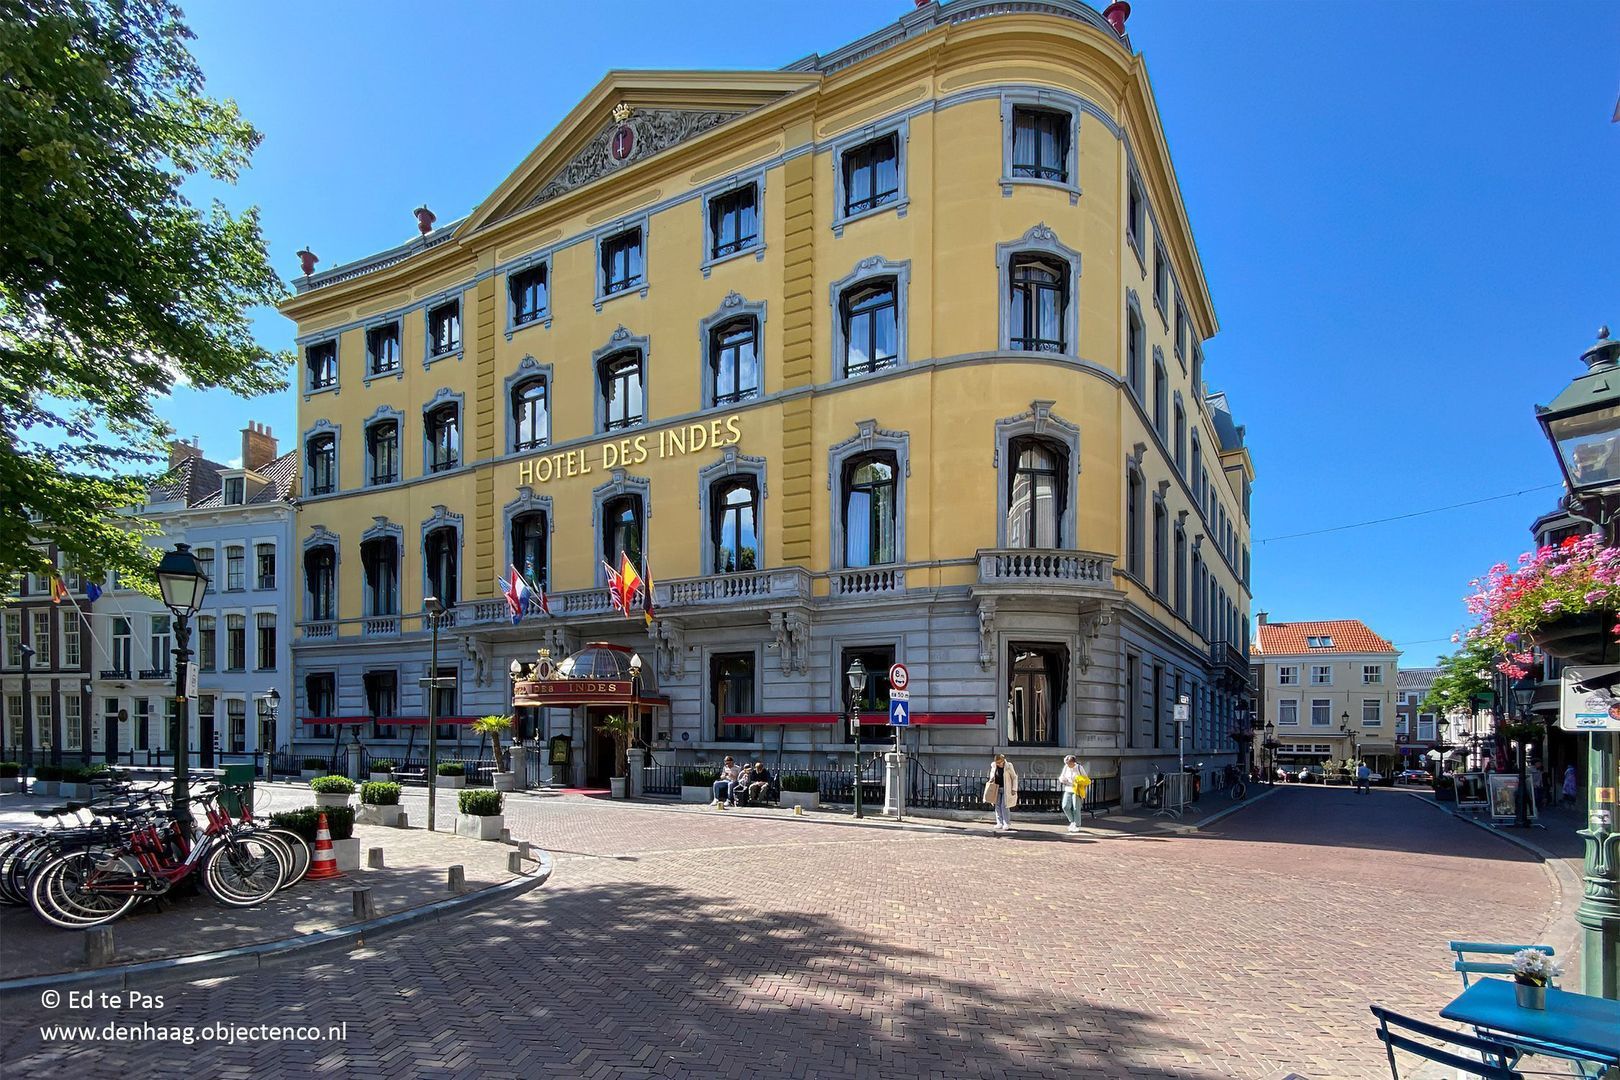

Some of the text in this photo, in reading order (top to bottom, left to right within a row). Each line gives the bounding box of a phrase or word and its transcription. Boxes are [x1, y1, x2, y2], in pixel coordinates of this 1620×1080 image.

[519, 415, 742, 485] HOTEL DES INDES
[568, 683, 617, 693] INDES
